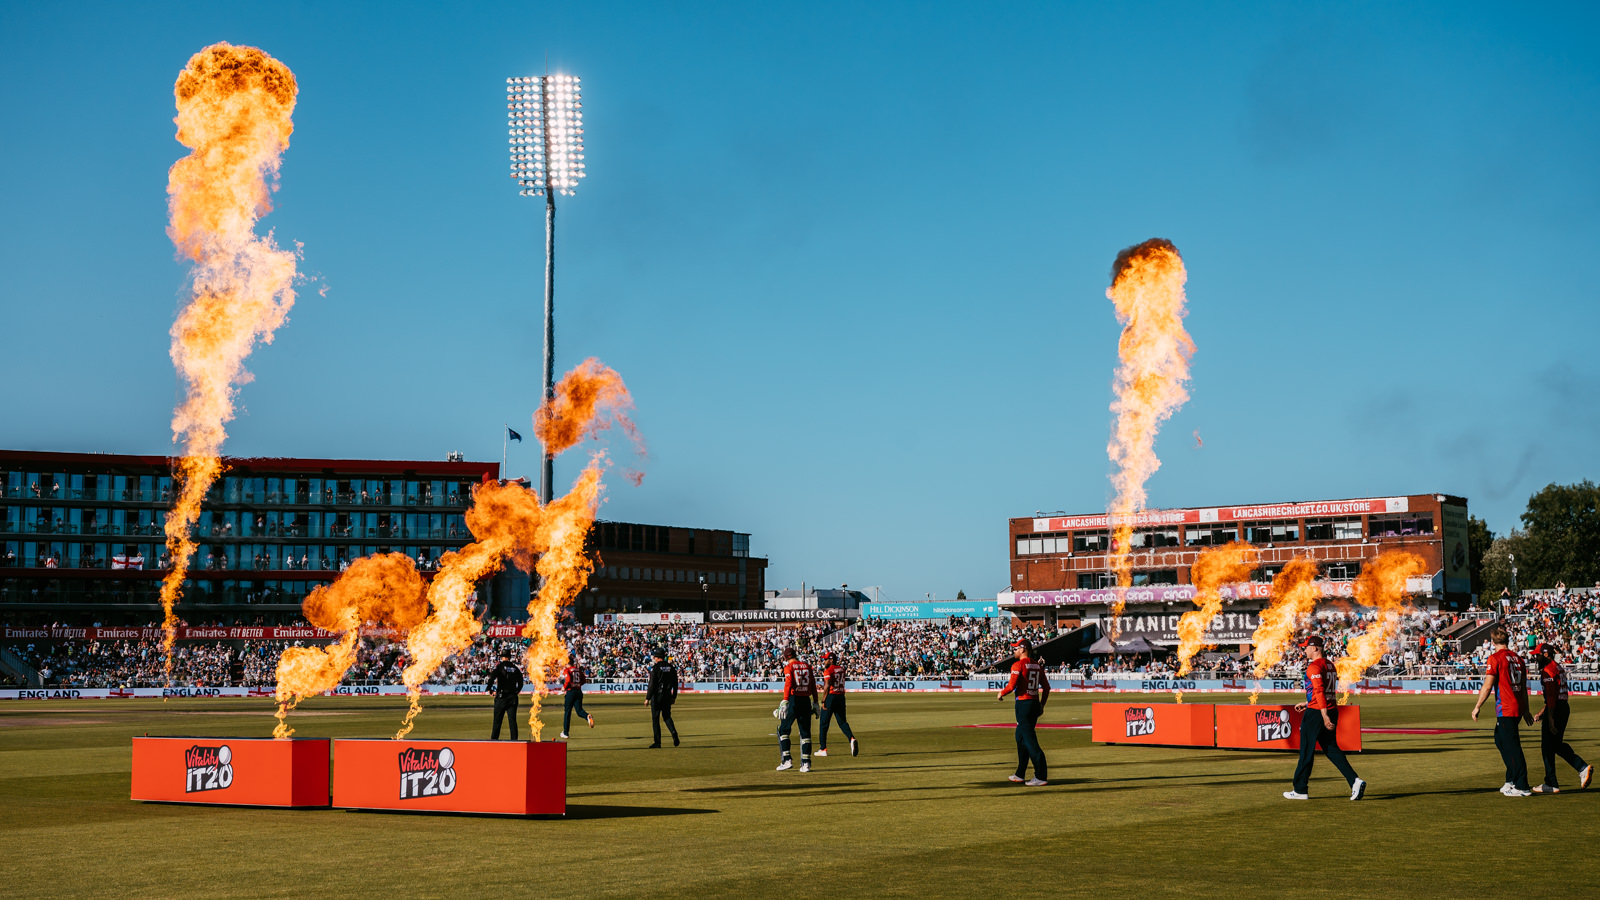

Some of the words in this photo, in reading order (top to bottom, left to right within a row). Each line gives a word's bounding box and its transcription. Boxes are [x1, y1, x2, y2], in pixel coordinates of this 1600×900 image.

[1232, 502, 1371, 518] LANCASHIRECRICKET.CO.UK/STORE
[1090, 591, 1117, 602] cinch
[1163, 588, 1191, 600] cinch
[1255, 586, 1268, 596] IG
[1019, 593, 1046, 604] cinch
[1054, 592, 1081, 603] cinch
[884, 605, 919, 613] DICKINSON
[734, 611, 778, 620] INSURANCE
[780, 610, 815, 619] BROKERS
[5, 629, 49, 638] Emirates
[52, 629, 63, 638] FLY
[64, 628, 87, 638] BETTER
[96, 629, 139, 638] Emirates
[185, 628, 227, 637] Emirates
[230, 629, 241, 637] FLY
[241, 628, 263, 637] BETTER
[273, 628, 314, 637] Emirates
[495, 625, 516, 636] BETTER
[794, 669, 810, 686] 63
[834, 673, 845, 687] 34
[1028, 671, 1040, 689] 51
[861, 682, 915, 690] ENGLAND
[1142, 681, 1196, 690] ENGLAND
[1429, 681, 1483, 690] ENGLAND
[18, 690, 80, 698] ENGLAND
[162, 688, 220, 696] ENGLAND
[1256, 710, 1280, 727] Vitality
[1127, 719, 1155, 737] IT20
[1257, 722, 1291, 741] IT20
[187, 747, 219, 771] Vitality
[401, 750, 439, 776] Vitality
[187, 764, 233, 791] IT20
[400, 767, 456, 798] IT20
